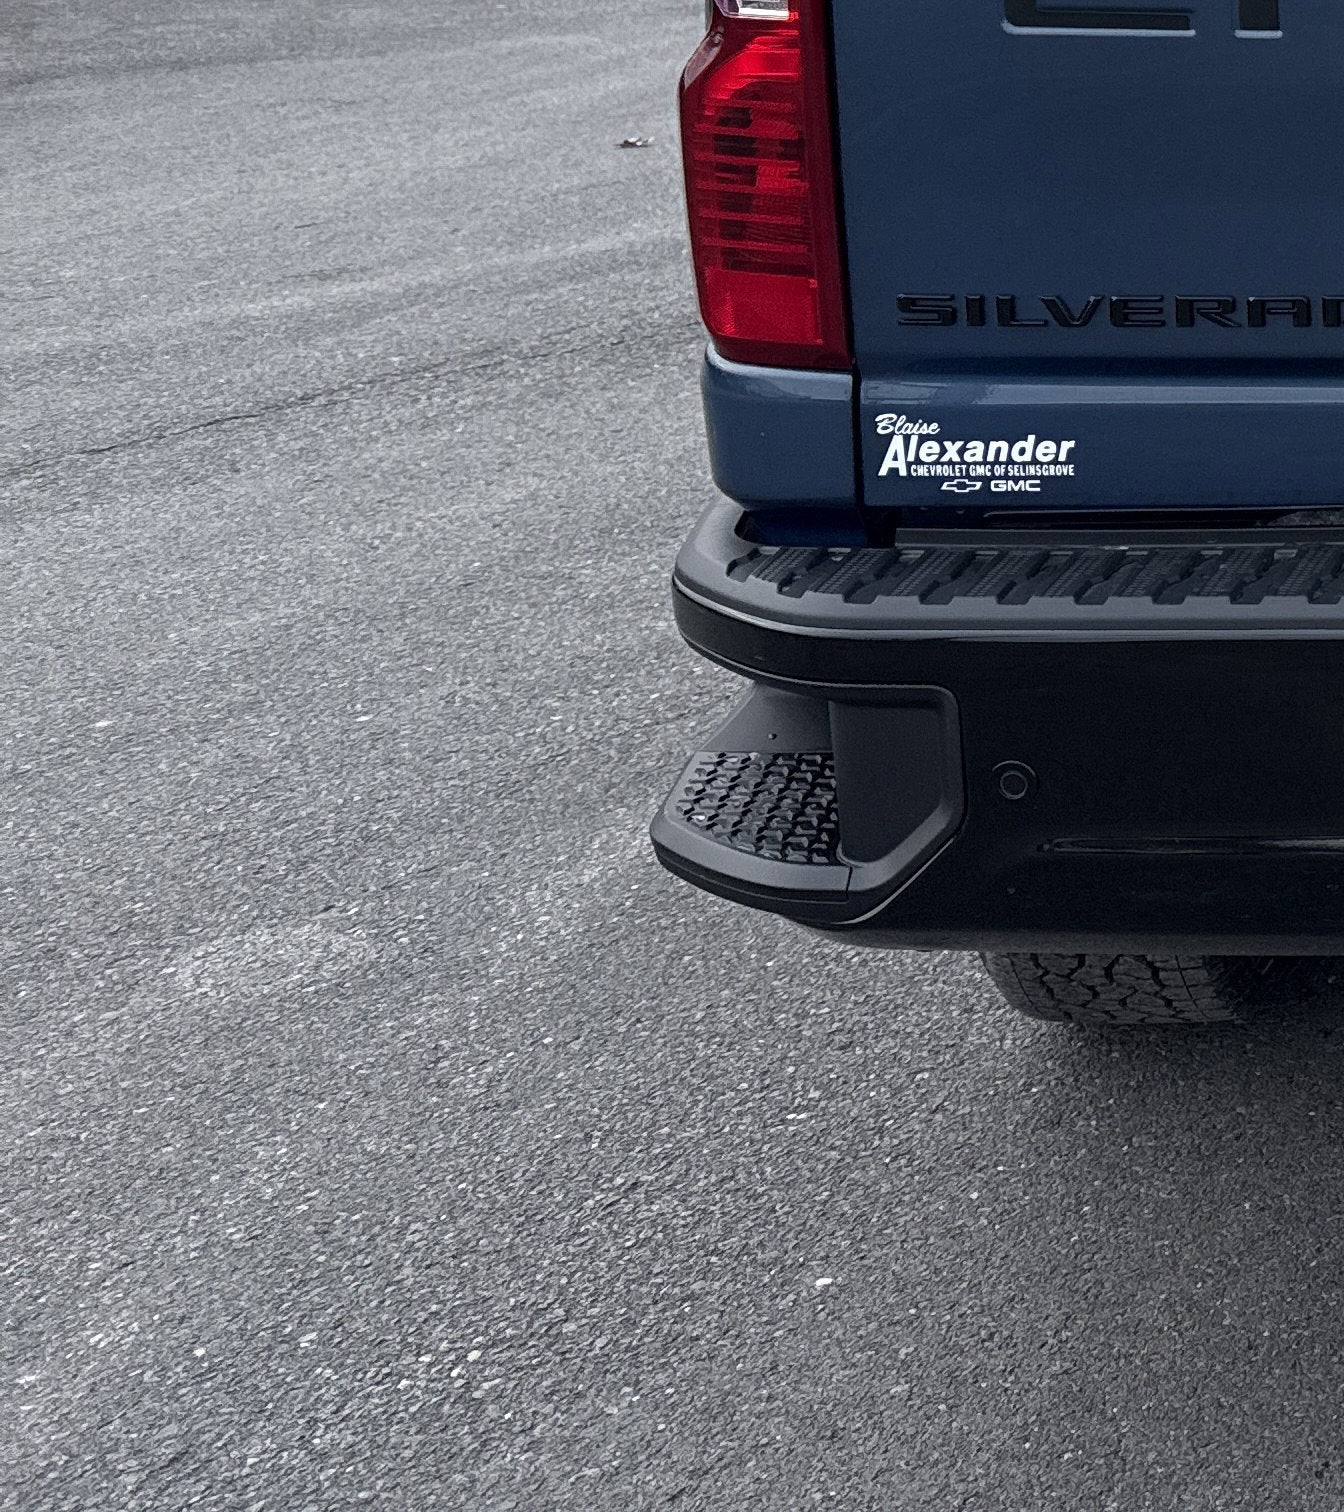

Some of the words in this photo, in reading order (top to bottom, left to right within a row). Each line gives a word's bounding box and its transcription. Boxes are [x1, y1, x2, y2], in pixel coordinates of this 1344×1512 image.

[874, 413, 941, 435] Blaise
[877, 434, 1076, 477] Alexander
[910, 464, 967, 477] CHEVROLET
[969, 464, 992, 477] GMC
[994, 464, 1006, 477] OF
[1007, 464, 1075, 477] SELINSGROVE
[990, 479, 1041, 492] GMC
